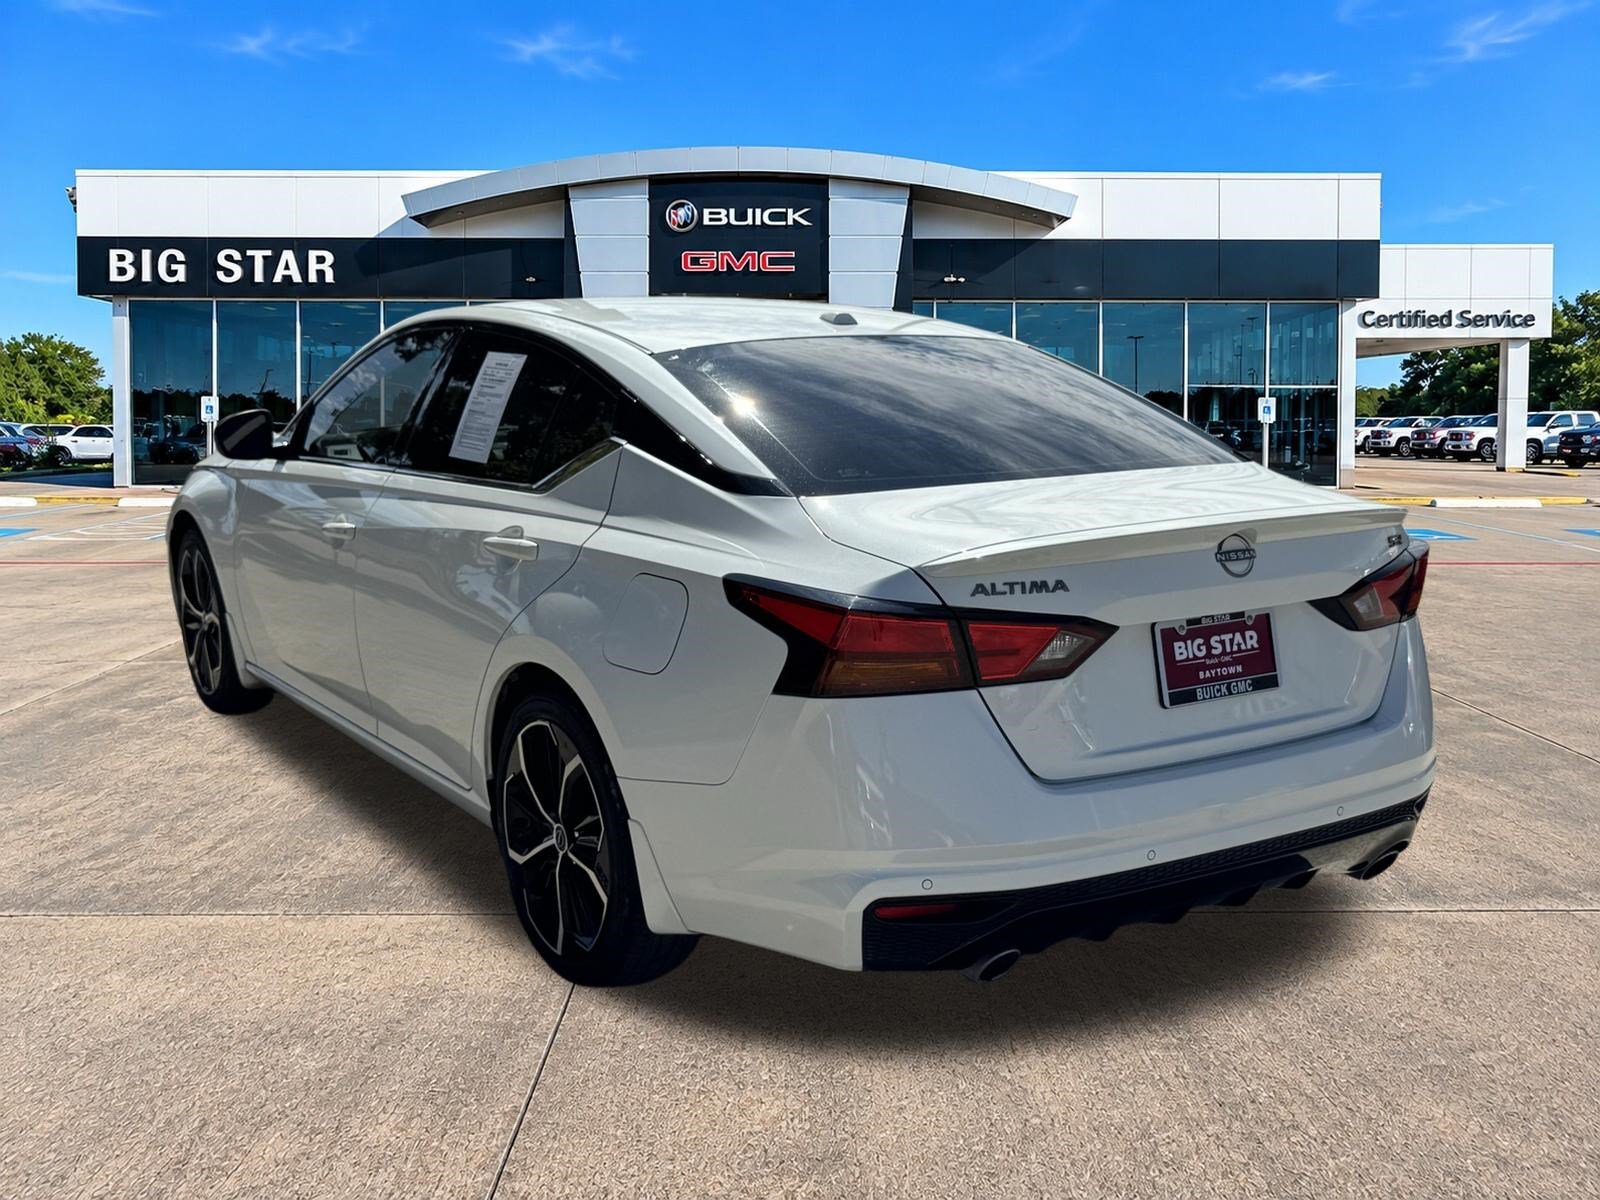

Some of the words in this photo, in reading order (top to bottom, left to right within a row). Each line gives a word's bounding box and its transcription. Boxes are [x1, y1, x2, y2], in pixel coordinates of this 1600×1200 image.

[703, 208, 813, 226] BUICK
[108, 248, 187, 283] BIG
[215, 248, 336, 284] STAR
[681, 250, 796, 272] GMC
[1359, 309, 1453, 328] Certified
[1455, 309, 1536, 328] Service
[1216, 550, 1256, 561] NISSAN
[970, 579, 1070, 597] ALTIMA
[1214, 614, 1231, 622] STAR
[1173, 638, 1207, 661] BIG
[1210, 630, 1259, 655] STAR
[1199, 665, 1242, 679] BAYTOWN
[1196, 685, 1229, 700] BUICK
[1230, 680, 1253, 695] GMC
